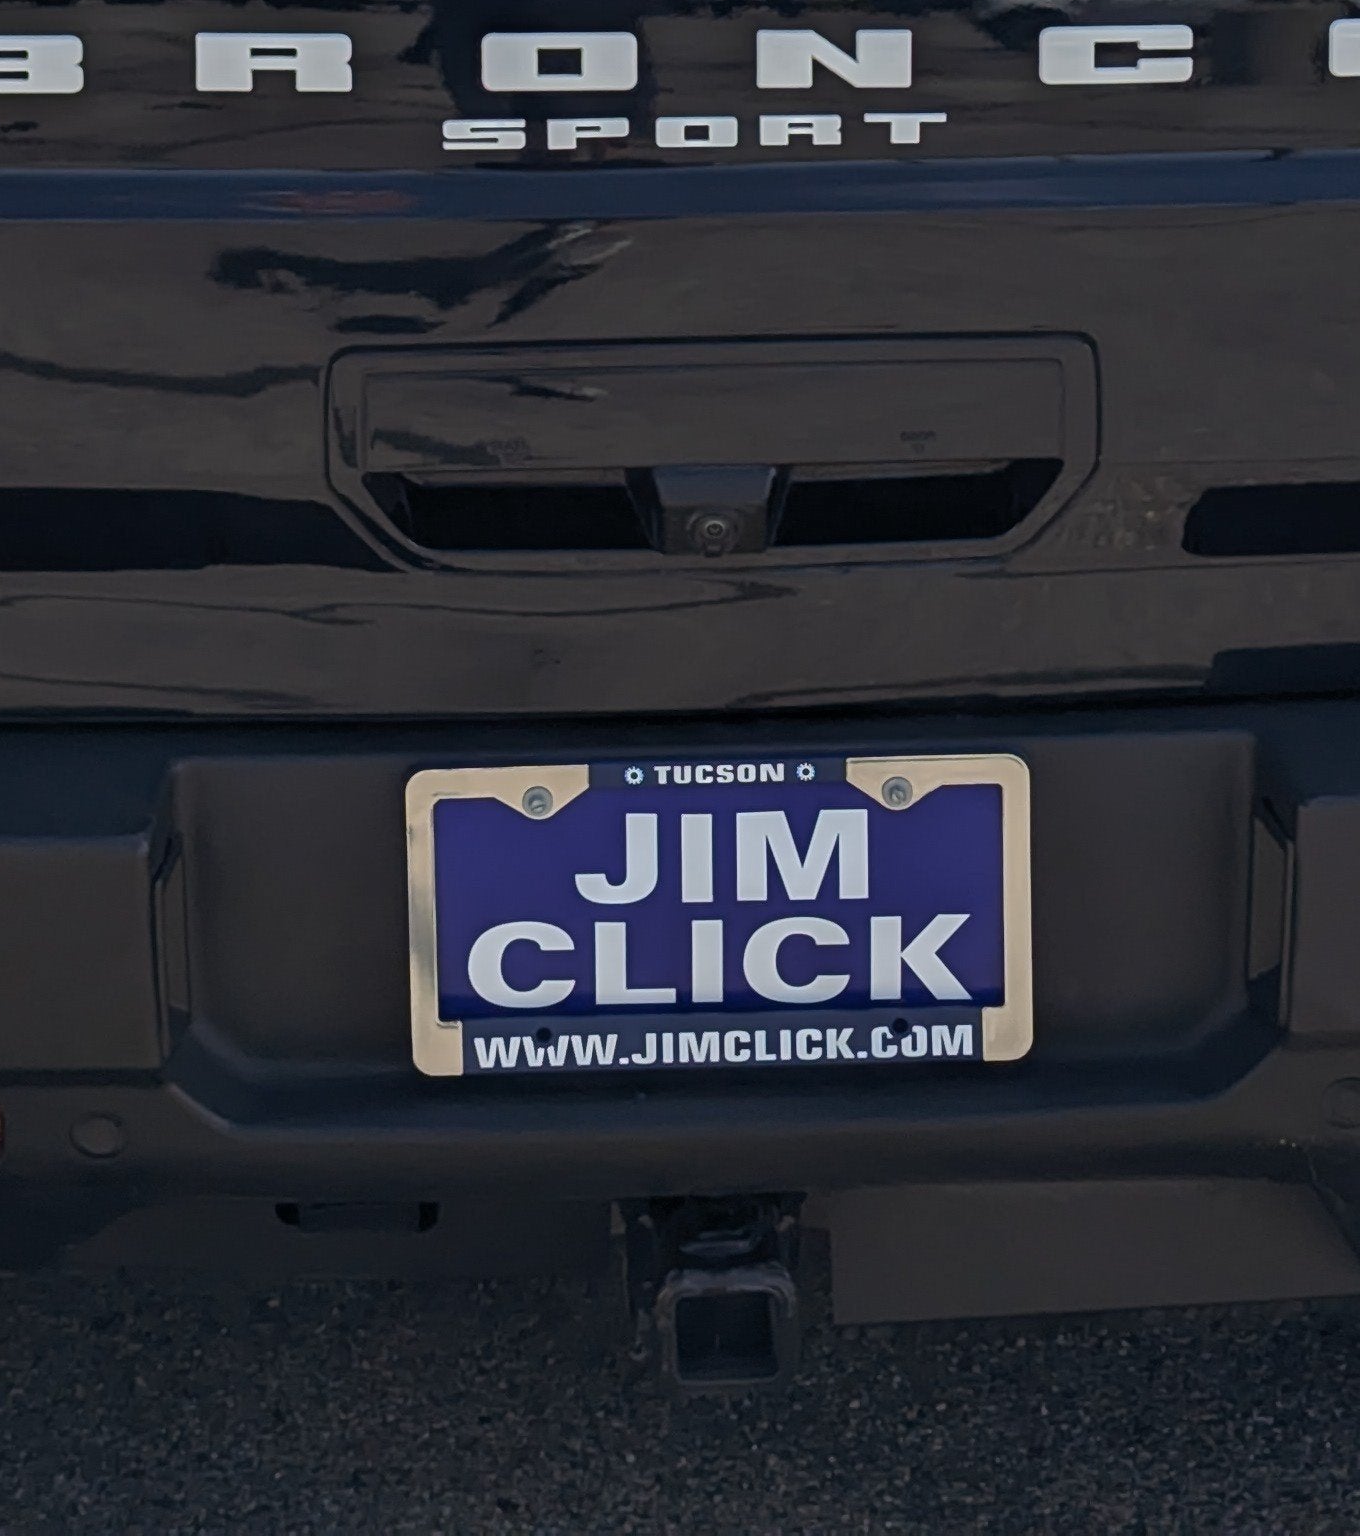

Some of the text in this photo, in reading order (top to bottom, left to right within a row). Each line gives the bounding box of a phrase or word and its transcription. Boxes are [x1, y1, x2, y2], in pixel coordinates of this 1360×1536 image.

[442, 111, 948, 152] SPORT
[653, 762, 785, 785] TUCSON
[574, 808, 870, 905] JIM
[467, 913, 971, 1009] CLICK
[473, 1024, 974, 1069] WWW.JIMCLICK.COM
